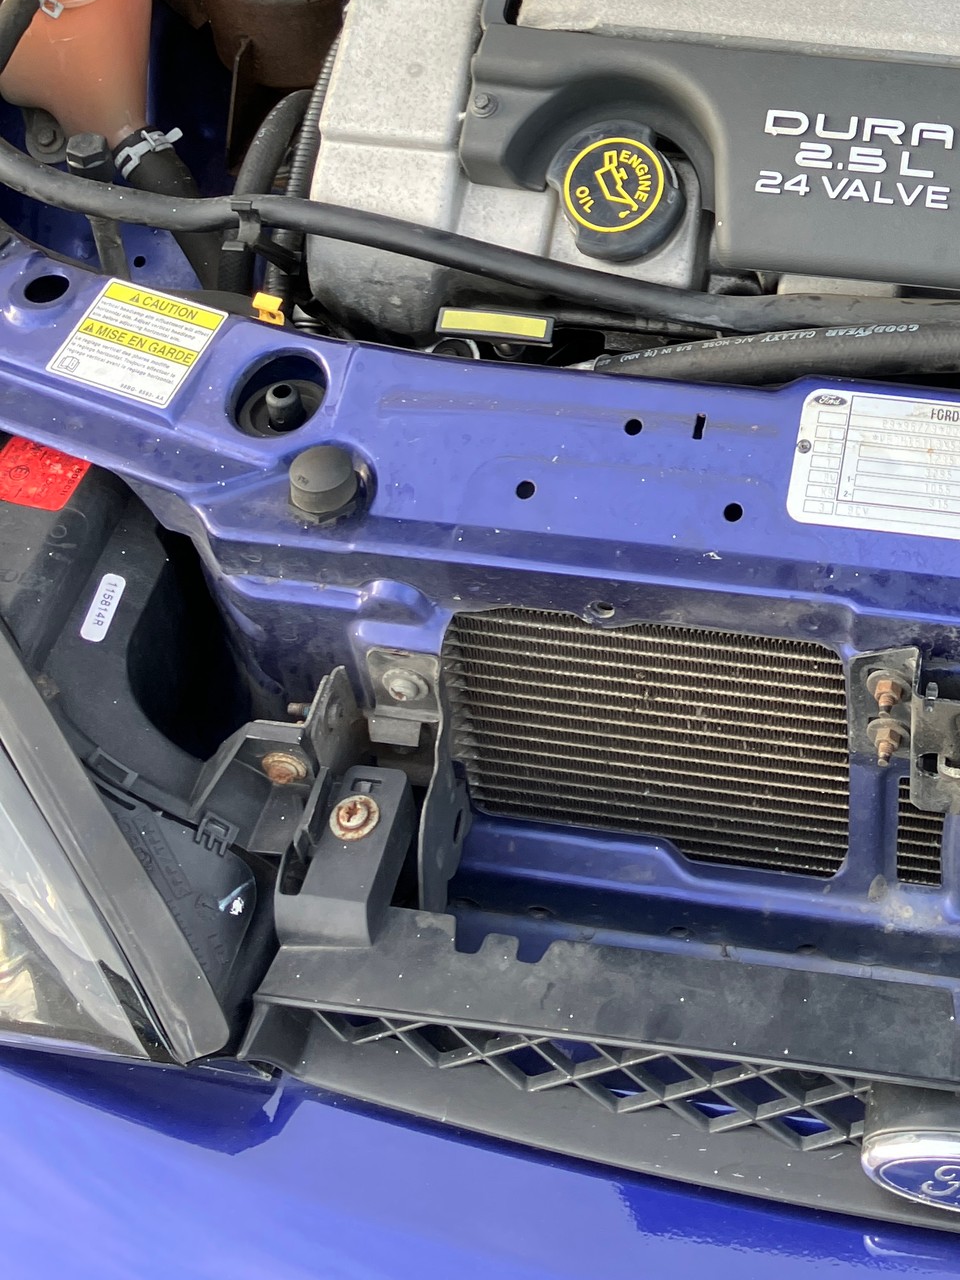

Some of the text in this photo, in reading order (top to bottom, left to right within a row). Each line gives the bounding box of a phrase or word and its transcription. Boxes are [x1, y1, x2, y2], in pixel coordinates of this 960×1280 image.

[619, 149, 652, 202] ENGINE
[575, 186, 595, 213] OIL
[755, 170, 810, 196] 24
[821, 175, 951, 210] VALVE
[142, 296, 199, 321] CAUTION
[735, 336, 755, 346] A/C
[761, 330, 816, 343] GALAXY
[825, 323, 920, 338] GOODYEAR
[96, 325, 194, 364] MISE EN GARDE
[701, 340, 731, 350] HOSE
[92, 582, 118, 627] 115814R
